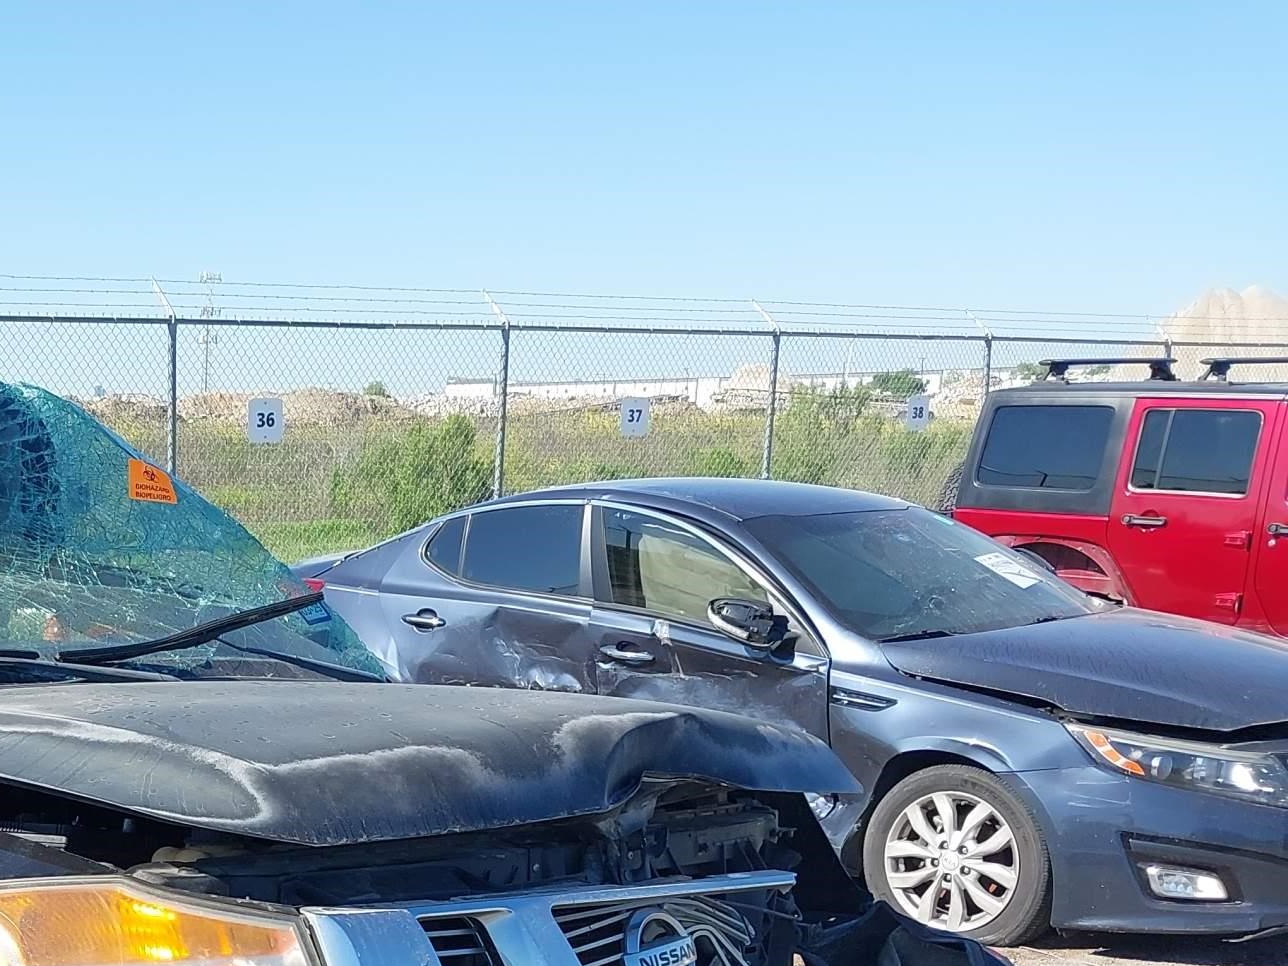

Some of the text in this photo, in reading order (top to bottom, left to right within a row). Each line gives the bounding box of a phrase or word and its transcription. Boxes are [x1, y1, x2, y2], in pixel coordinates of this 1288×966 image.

[628, 409, 643, 423] 37
[912, 406, 924, 419] 38
[257, 412, 275, 428] 36
[135, 491, 171, 501] BIOPELIGRO
